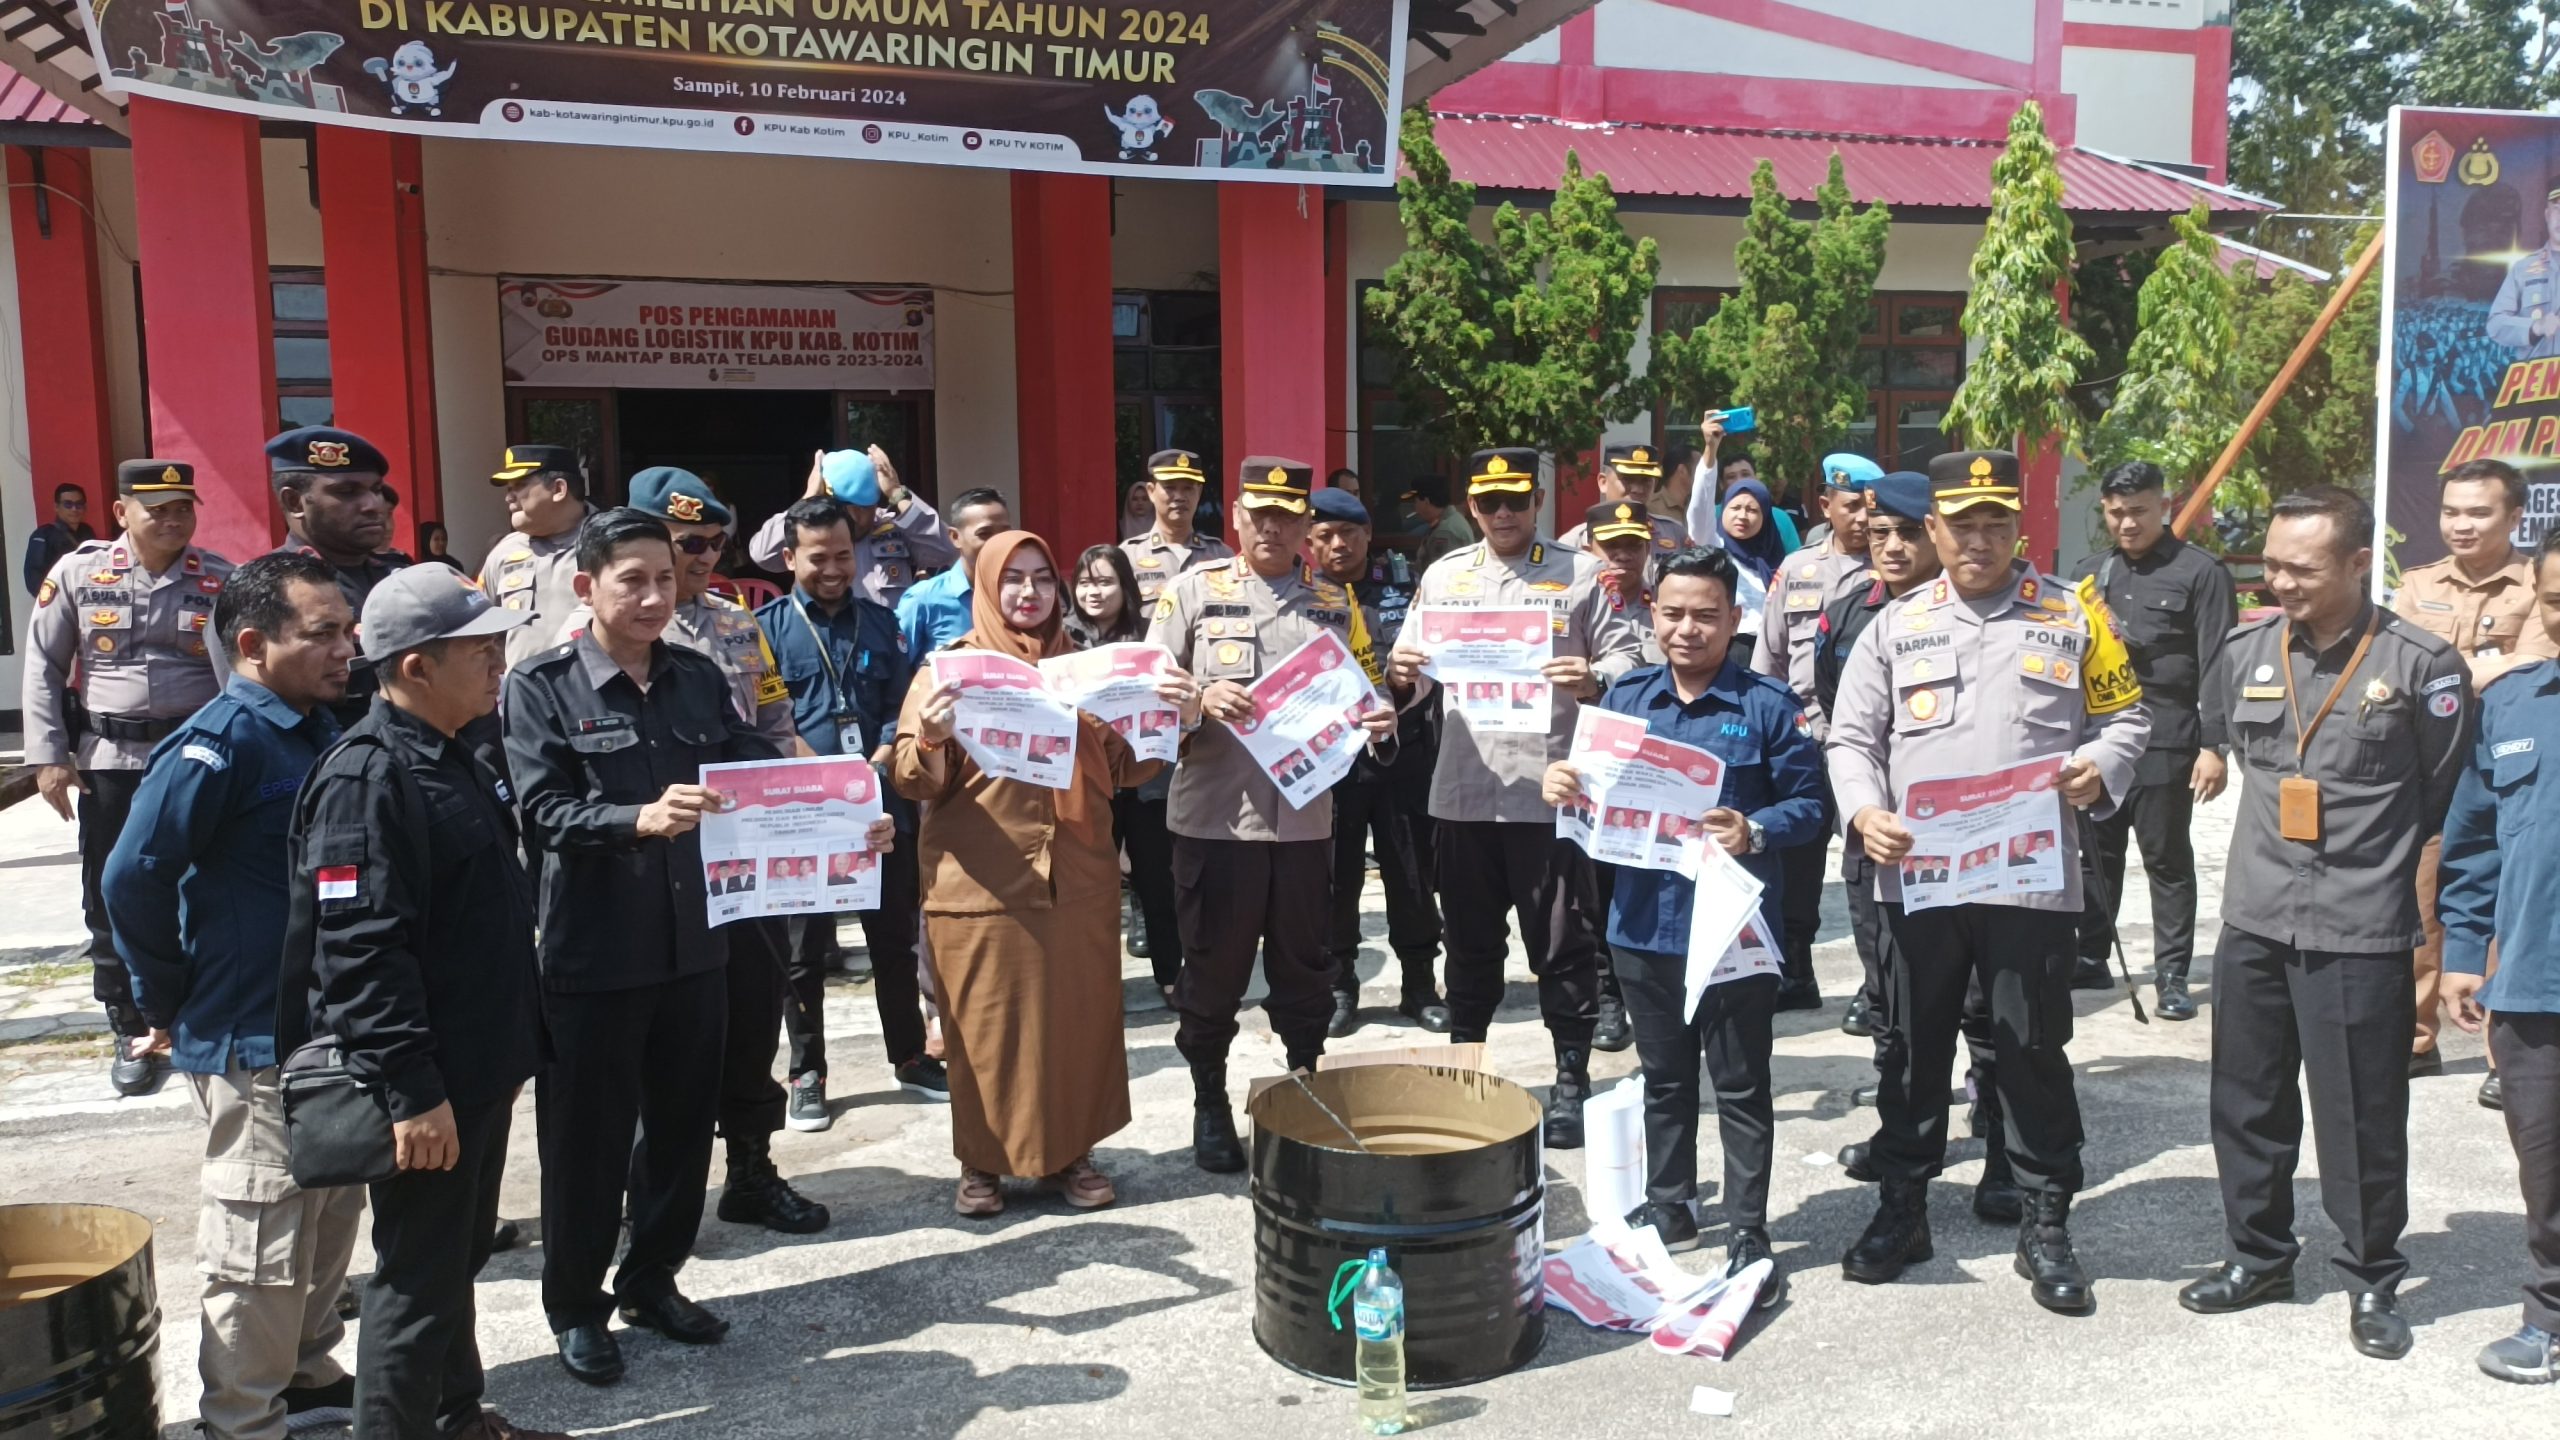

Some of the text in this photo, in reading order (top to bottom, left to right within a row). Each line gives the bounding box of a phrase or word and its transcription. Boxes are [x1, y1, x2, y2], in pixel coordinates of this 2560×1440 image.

[812, 0, 950, 28] UMUM
[962, 0, 1107, 39] TAHUN
[1118, 8, 1210, 45] 2024
[360, 0, 409, 31] DI
[425, 0, 691, 51] KABUPATEN
[707, 21, 1033, 76] KOTAWARINGIN
[1046, 45, 1176, 83] TIMUR
[673, 77, 907, 106] Sampit, 10 Februari 2024
[529, 108, 714, 129] kab-kotawaringintimur.kpu.go.id
[763, 123, 846, 138] KPU Kab Kotim
[887, 130, 950, 144] KPU_Kotim
[988, 138, 1065, 152] KPU TV KOTIM
[639, 305, 837, 328] POS PENGAMANAN
[545, 325, 919, 351] GUDANG LOGISTIK KPU KAB. KOTIM
[541, 349, 924, 367] OPS MANTAP BRATA TELABANG 2023-2024
[183, 594, 214, 608] POL
[1306, 609, 1346, 625] POLRI
[1379, 608, 1407, 623] POL
[1894, 634, 1951, 656] SARPANI
[2024, 629, 2078, 652] POLRI
[1720, 722, 1749, 738] KPU
